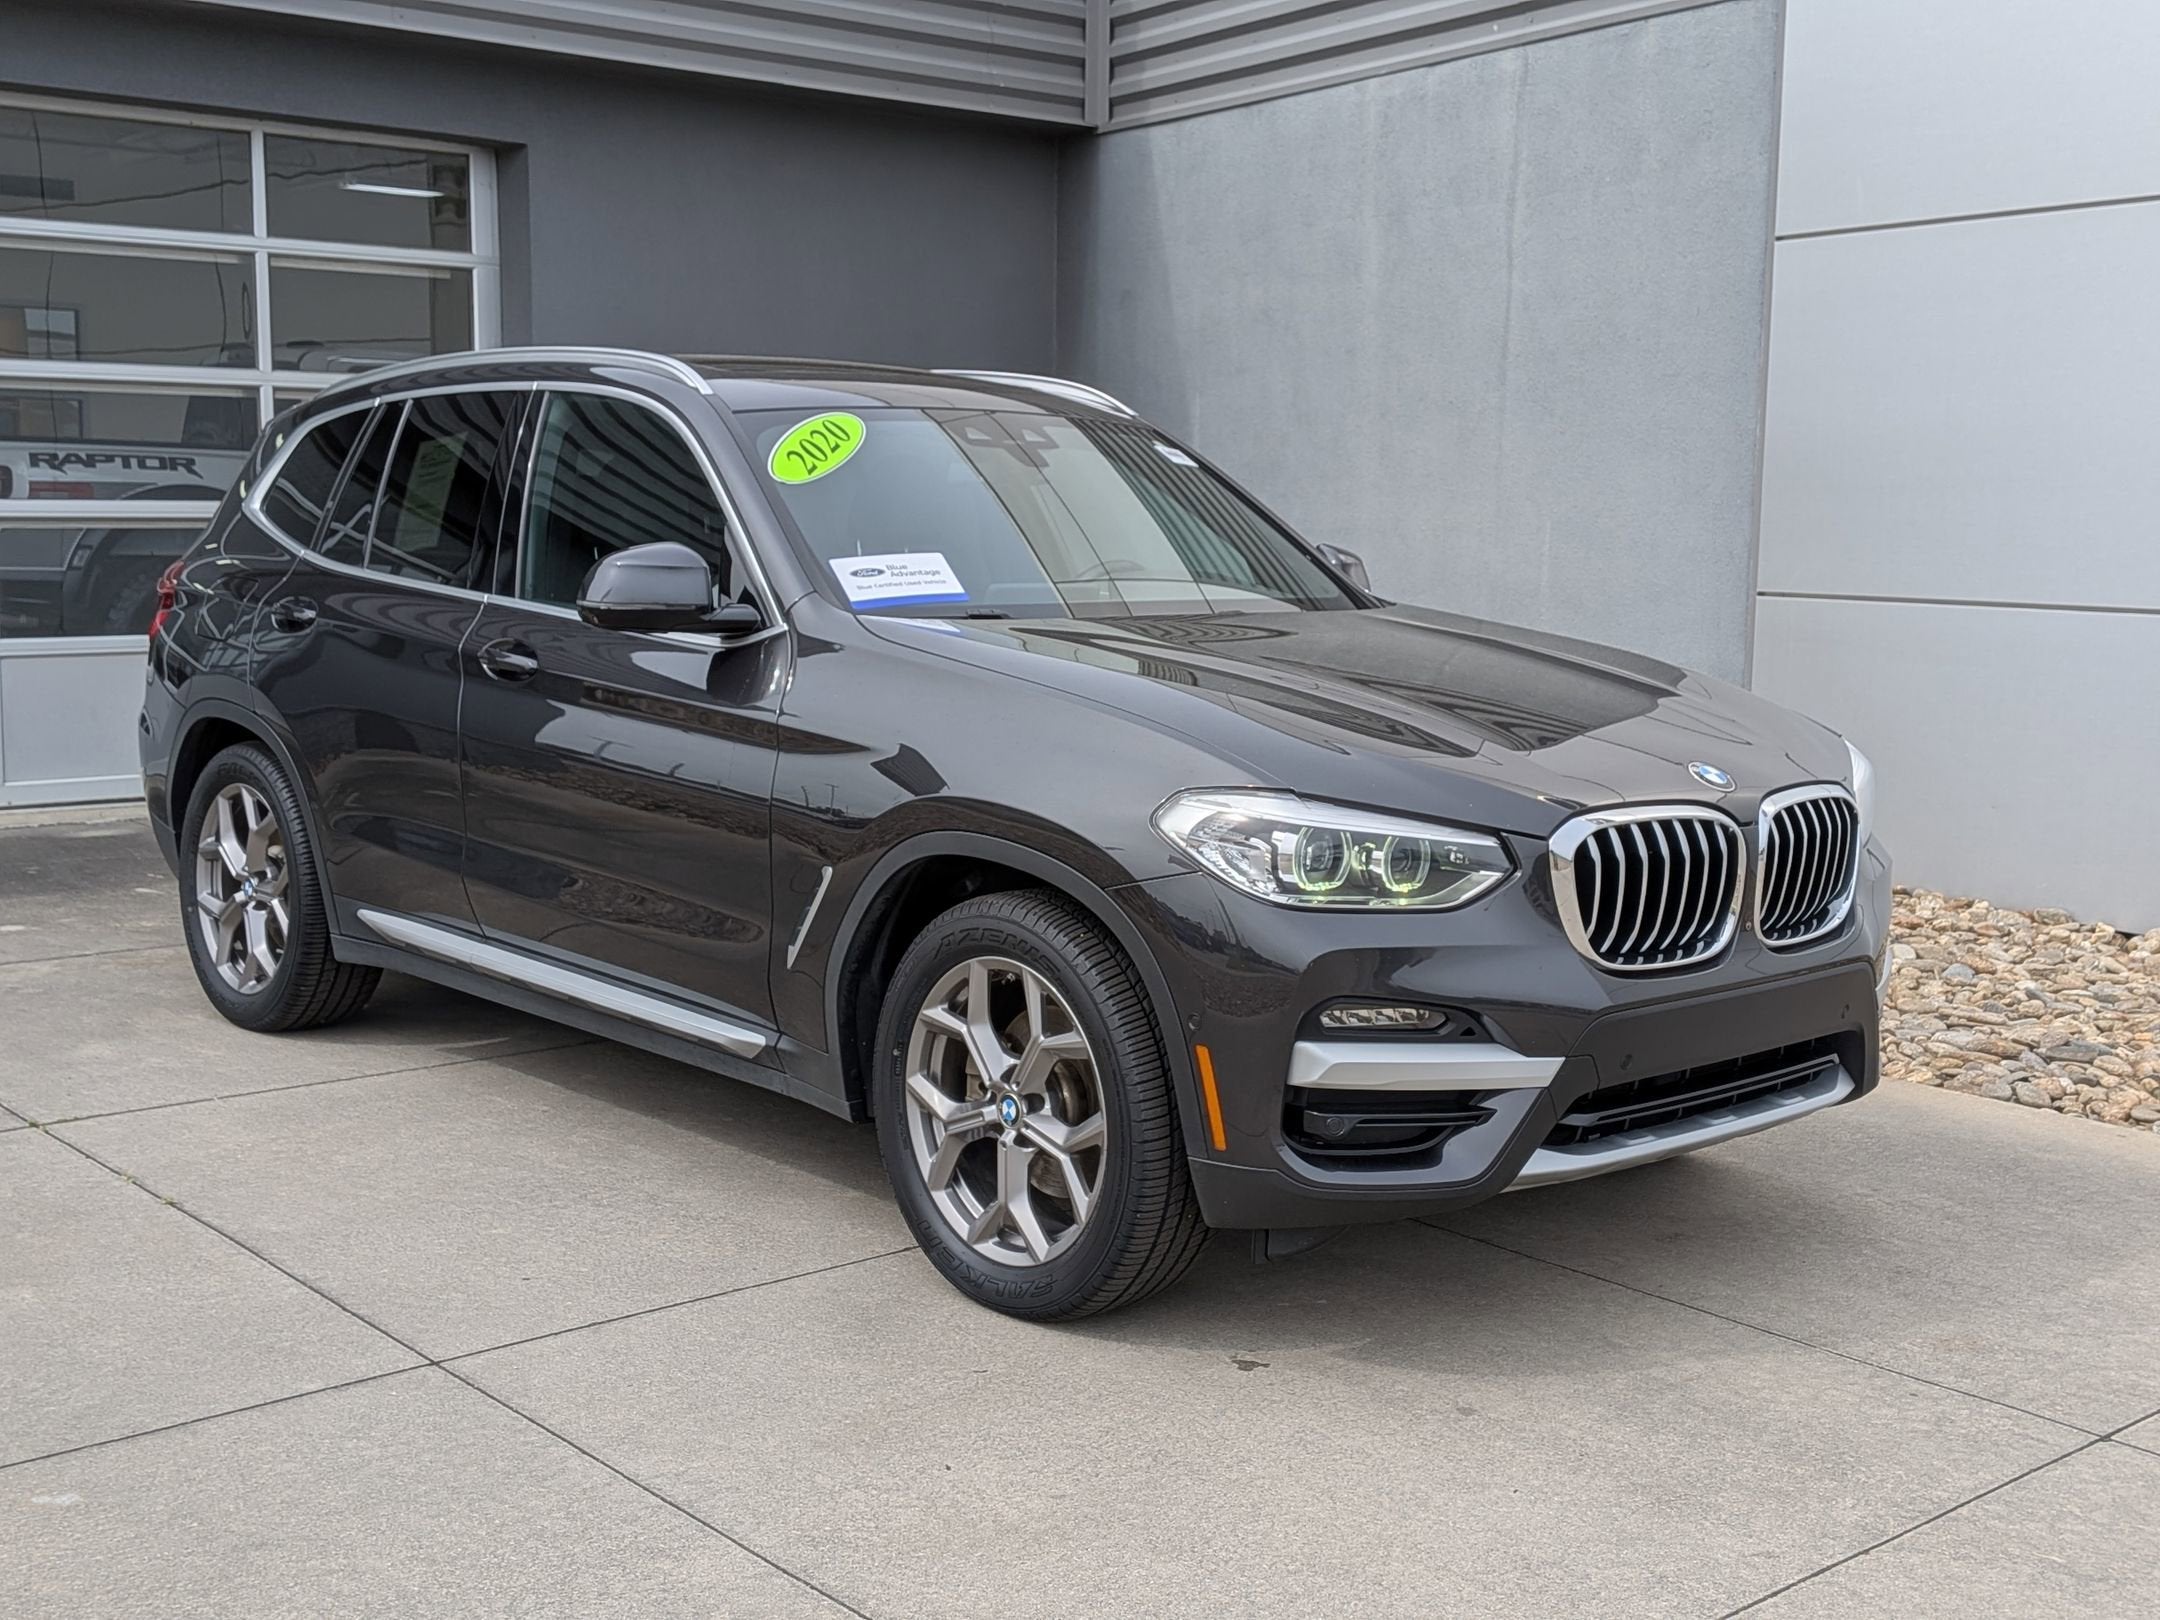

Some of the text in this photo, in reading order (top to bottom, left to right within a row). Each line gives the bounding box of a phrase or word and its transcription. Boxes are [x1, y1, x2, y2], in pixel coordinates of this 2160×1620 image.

[786, 419, 851, 475] 2020
[28, 452, 204, 479] RAPTOR
[885, 563, 908, 571] Blue
[890, 568, 941, 577] Advantage
